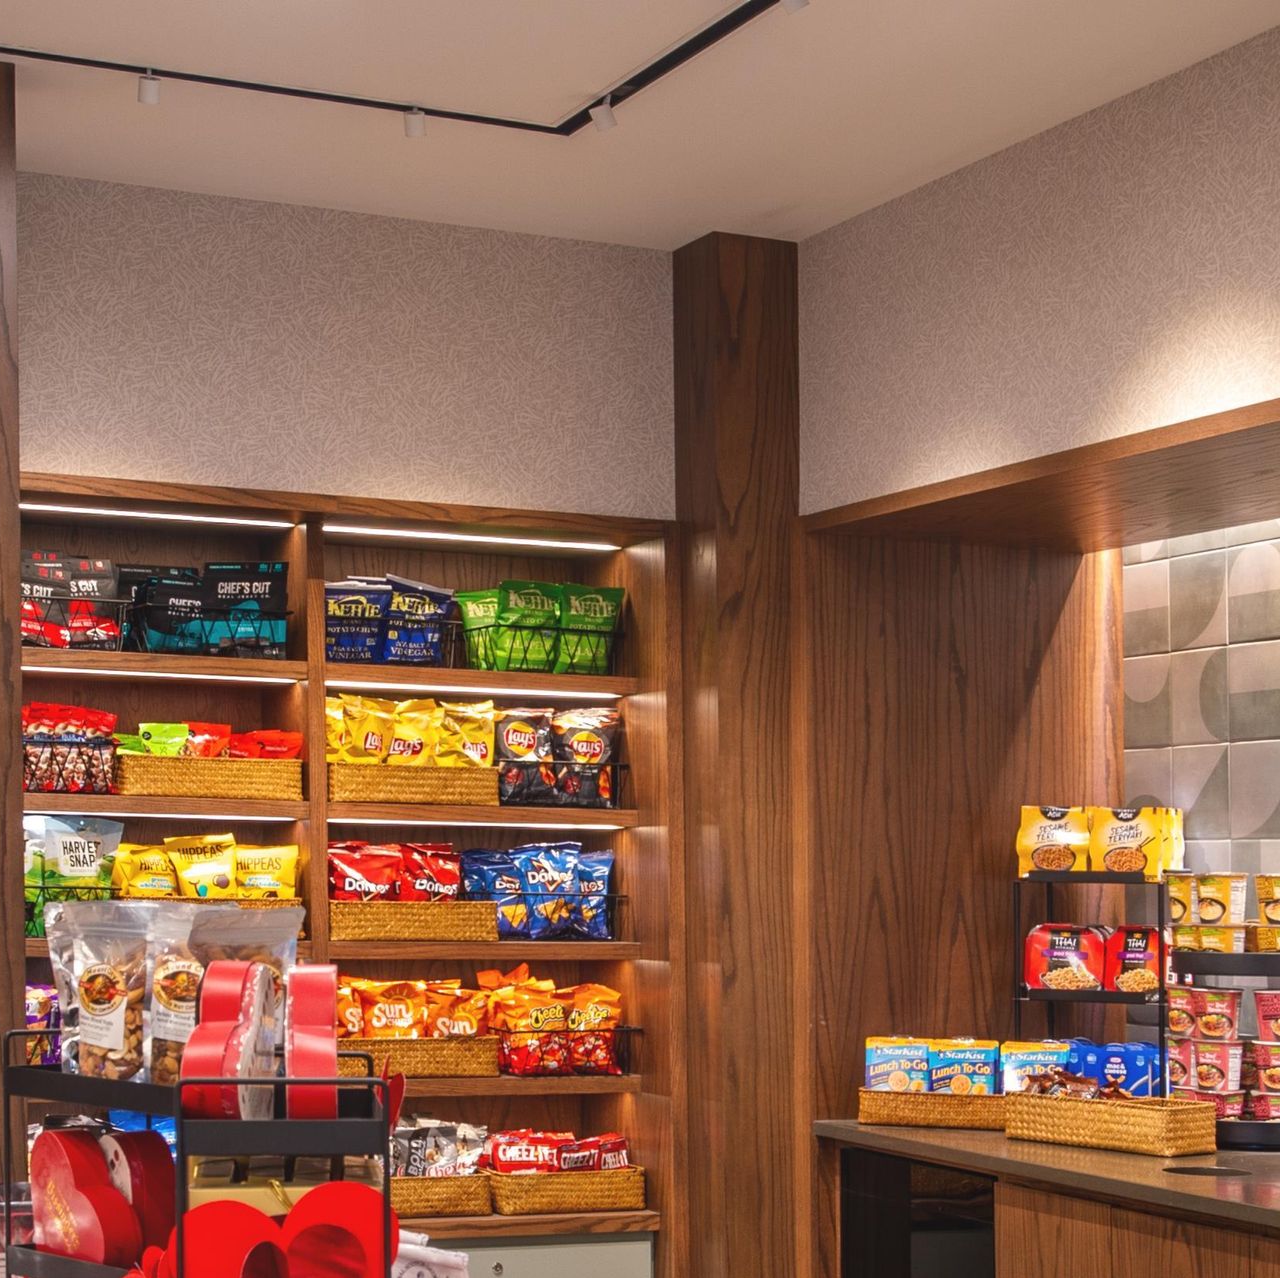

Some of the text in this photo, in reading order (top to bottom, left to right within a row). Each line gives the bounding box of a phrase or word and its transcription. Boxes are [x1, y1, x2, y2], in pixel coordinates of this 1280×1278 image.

[218, 582, 272, 594] CHEF'S CUT
[327, 597, 381, 617] KETTLE
[390, 591, 439, 614] KETTLE
[570, 595, 616, 617] KETTLE
[390, 647, 434, 657] VINEGAR
[1039, 823, 1070, 833] SESAME
[1111, 824, 1140, 835] SESAME
[1108, 832, 1142, 843] TERIYAKI
[178, 845, 223, 860] HIPPEAS
[236, 857, 282, 871] HIPPEAS
[528, 869, 573, 885] Doritos
[344, 877, 389, 893] Doritos
[415, 878, 459, 896] Doritos
[1053, 937, 1076, 946] THAI
[1127, 939, 1146, 948] THAI
[372, 1002, 411, 1028] Sun
[436, 1016, 477, 1037] Sun
[882, 1047, 923, 1056] StarKist
[945, 1050, 986, 1060] StarKist
[1017, 1053, 1057, 1062] StarKist
[870, 1060, 928, 1075] Lunch To-Go
[932, 1064, 991, 1080] Lunch To-Go
